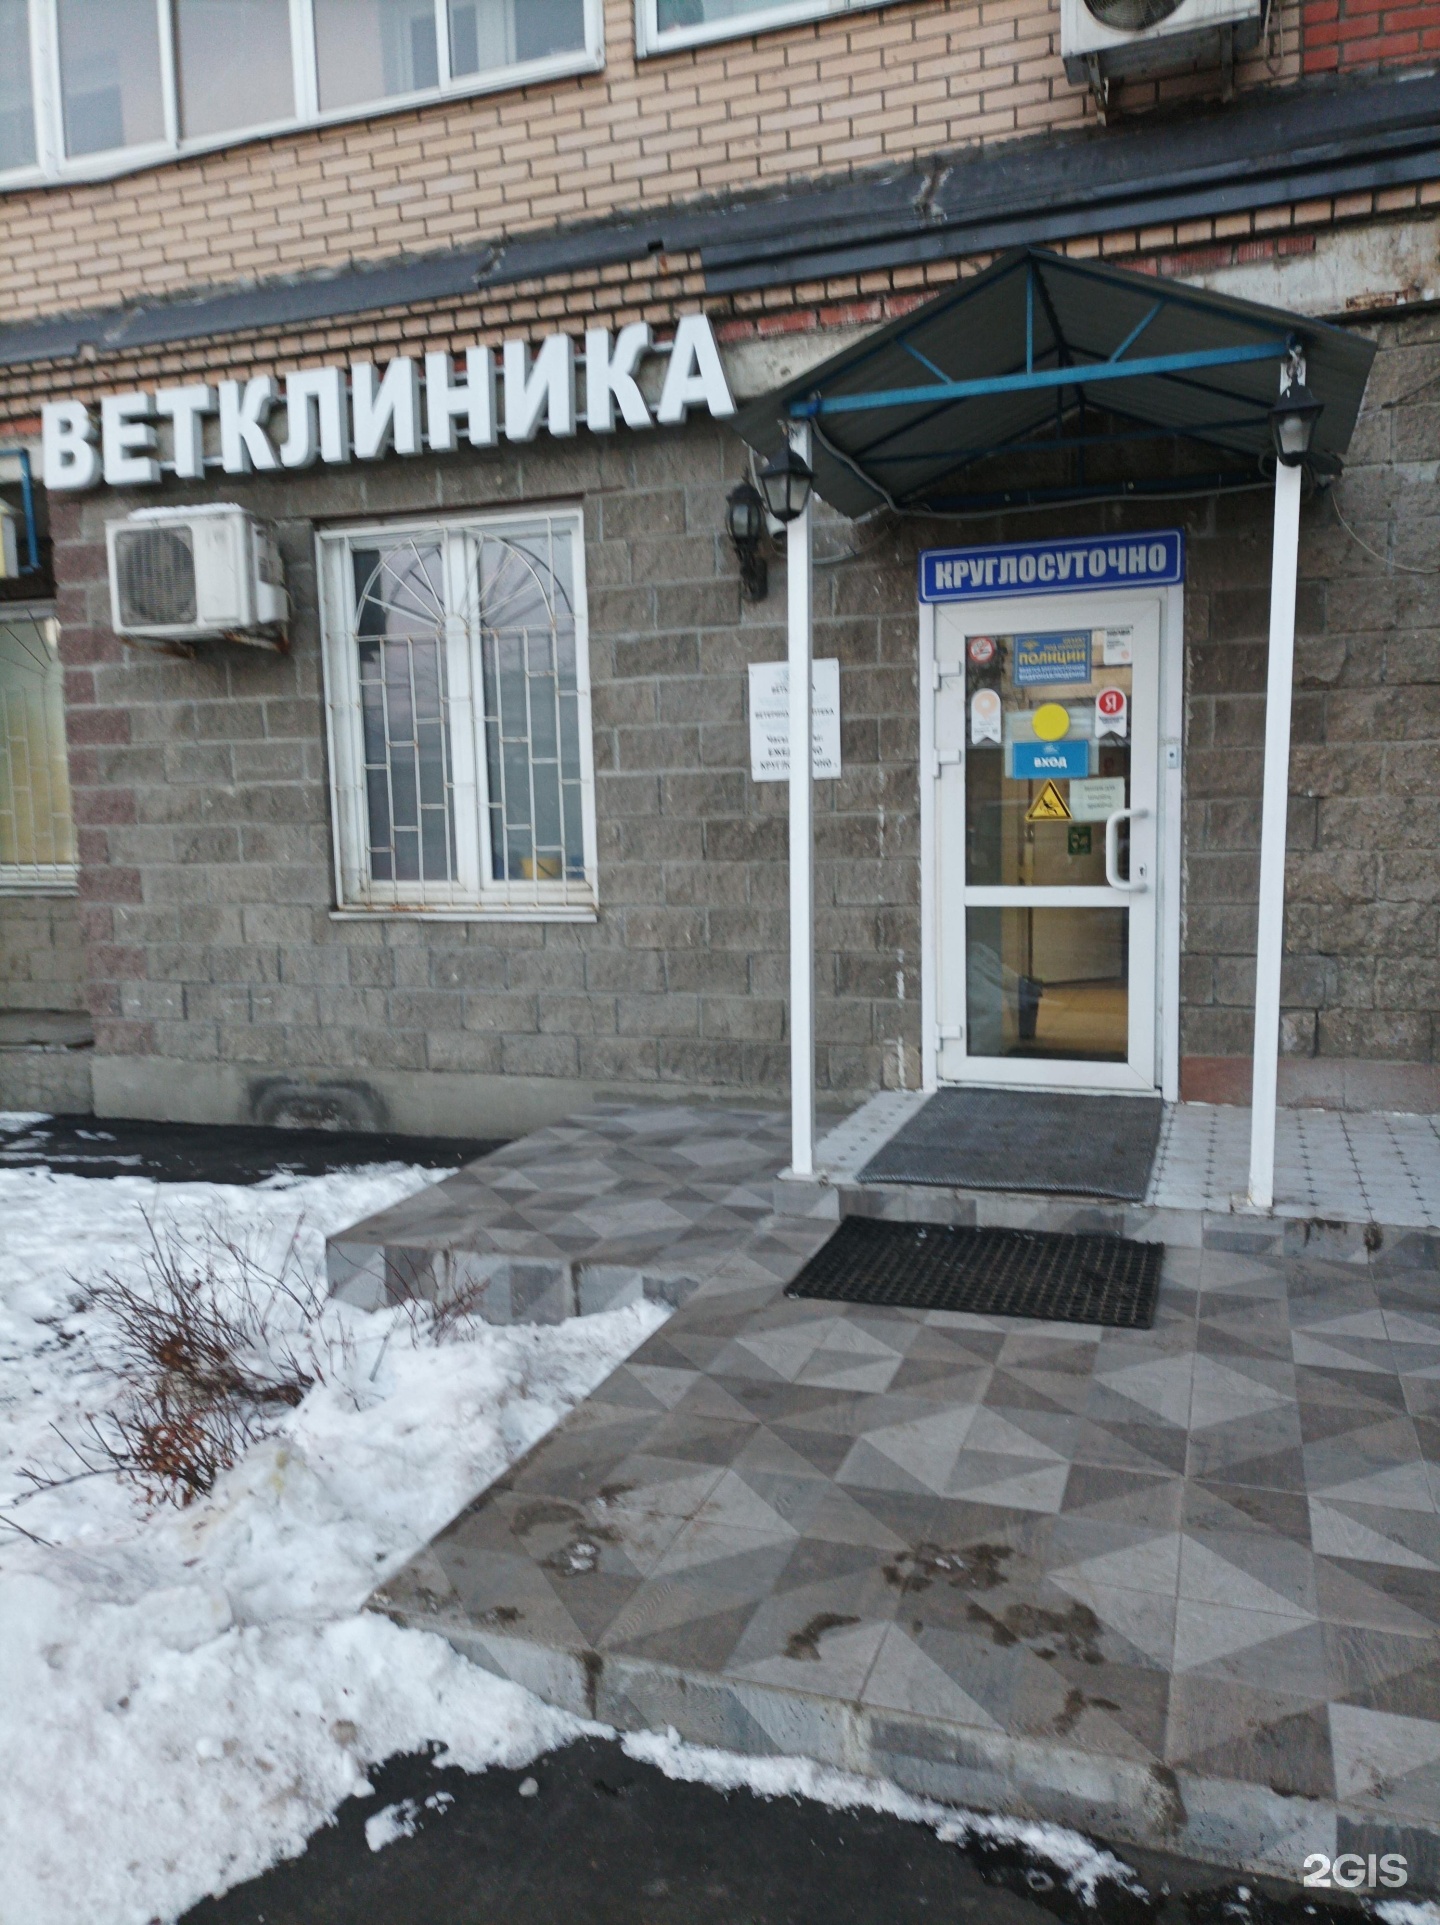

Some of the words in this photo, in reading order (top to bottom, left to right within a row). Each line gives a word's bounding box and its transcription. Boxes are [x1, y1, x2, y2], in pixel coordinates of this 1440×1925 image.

[41, 315, 738, 491] ВЕТКЛИНИКА
[935, 543, 1167, 590] КРУГЛОСУТОЧНО
[1019, 650, 1086, 665] ПОЛИЦИИ
[1105, 692, 1117, 711] Я
[1033, 756, 1067, 769] ВХОД
